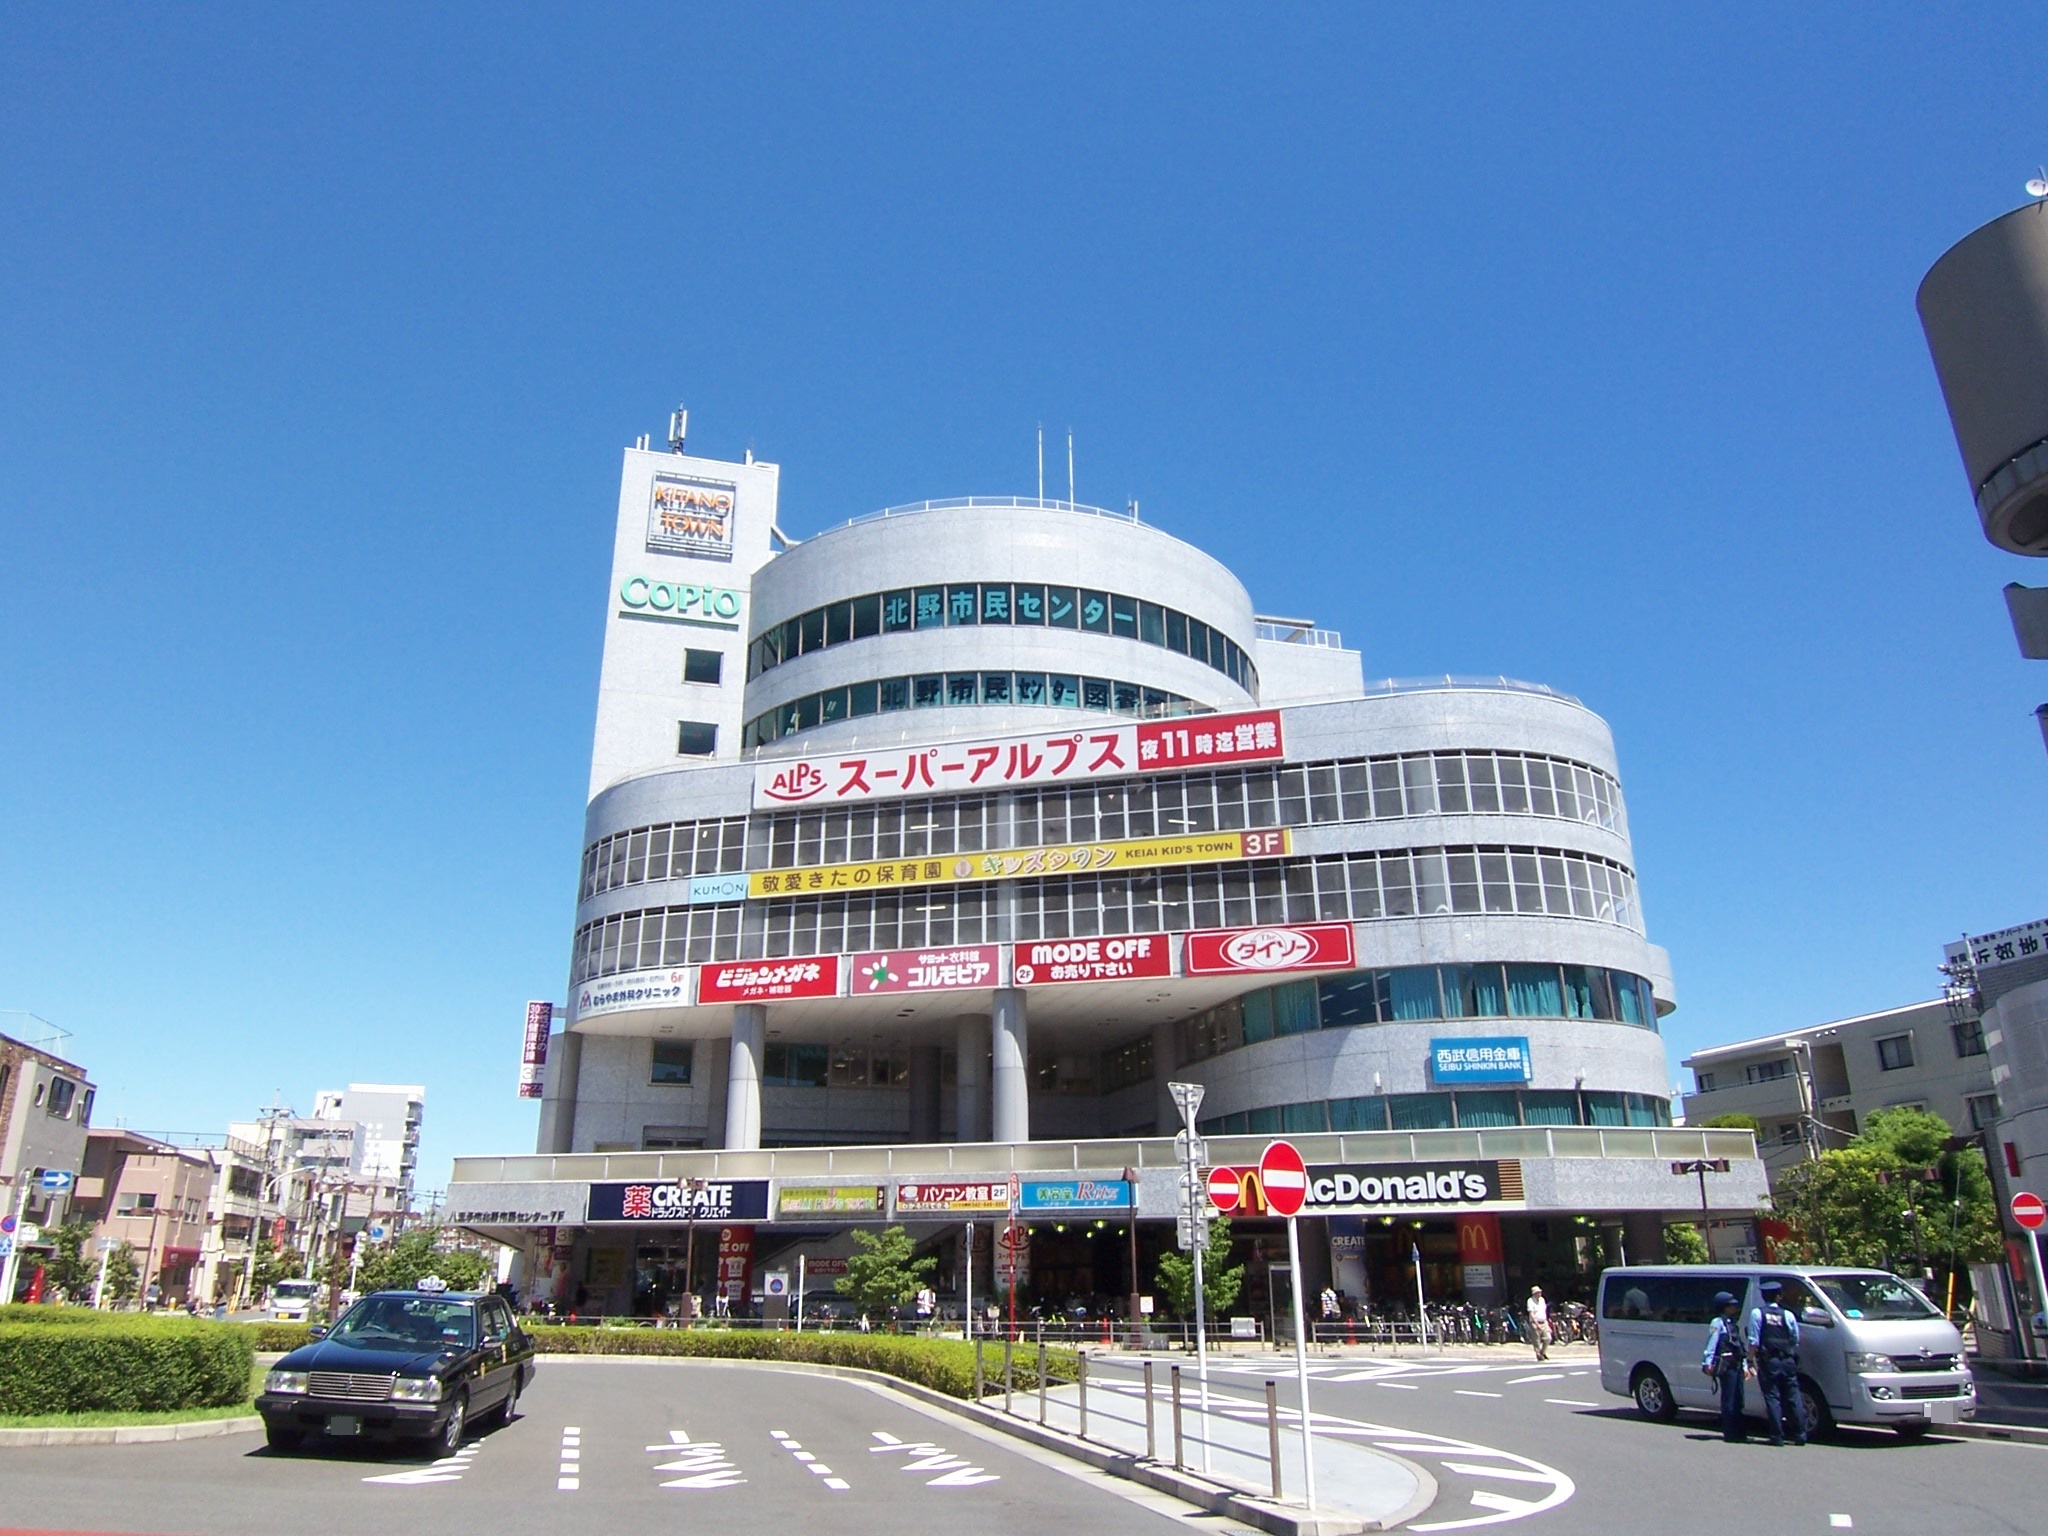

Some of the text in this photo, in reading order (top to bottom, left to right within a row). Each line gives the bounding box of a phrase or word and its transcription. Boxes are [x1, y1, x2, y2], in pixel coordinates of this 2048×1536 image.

[655, 485, 731, 510] KITANO
[661, 512, 724, 537] TOWN
[886, 591, 1134, 625] 北野市民センター
[1141, 722, 1277, 760] 夜11時迄営業
[837, 734, 1126, 797] スーパーアルプス
[772, 763, 822, 793] ALPS
[1125, 841, 1234, 859] KEIAI KID'S TOWN
[1246, 833, 1279, 855] 3F
[762, 861, 942, 893] 敬愛きたの保育園
[693, 881, 745, 896] KUMON
[1106, 938, 1149, 960] OFF
[1237, 940, 1307, 960] ダイソー
[716, 962, 821, 988] ビジョンメガネ
[907, 962, 990, 987] コルモピア
[1019, 968, 1032, 979] 2F
[1051, 962, 1133, 979] お売り下さい
[1437, 1047, 1521, 1063] 西武信用金庫
[1438, 1060, 1522, 1072] SEIBU SHINKIN BANK
[522, 1067, 545, 1080] 3F
[623, 1185, 652, 1218] 薬
[652, 1184, 733, 1207] CREATE
[923, 1186, 989, 1202] パソコン教室
[993, 1188, 1005, 1197] 2F
[1075, 1181, 1120, 1201] Ritz
[700, 1206, 731, 1218] クリエイト
